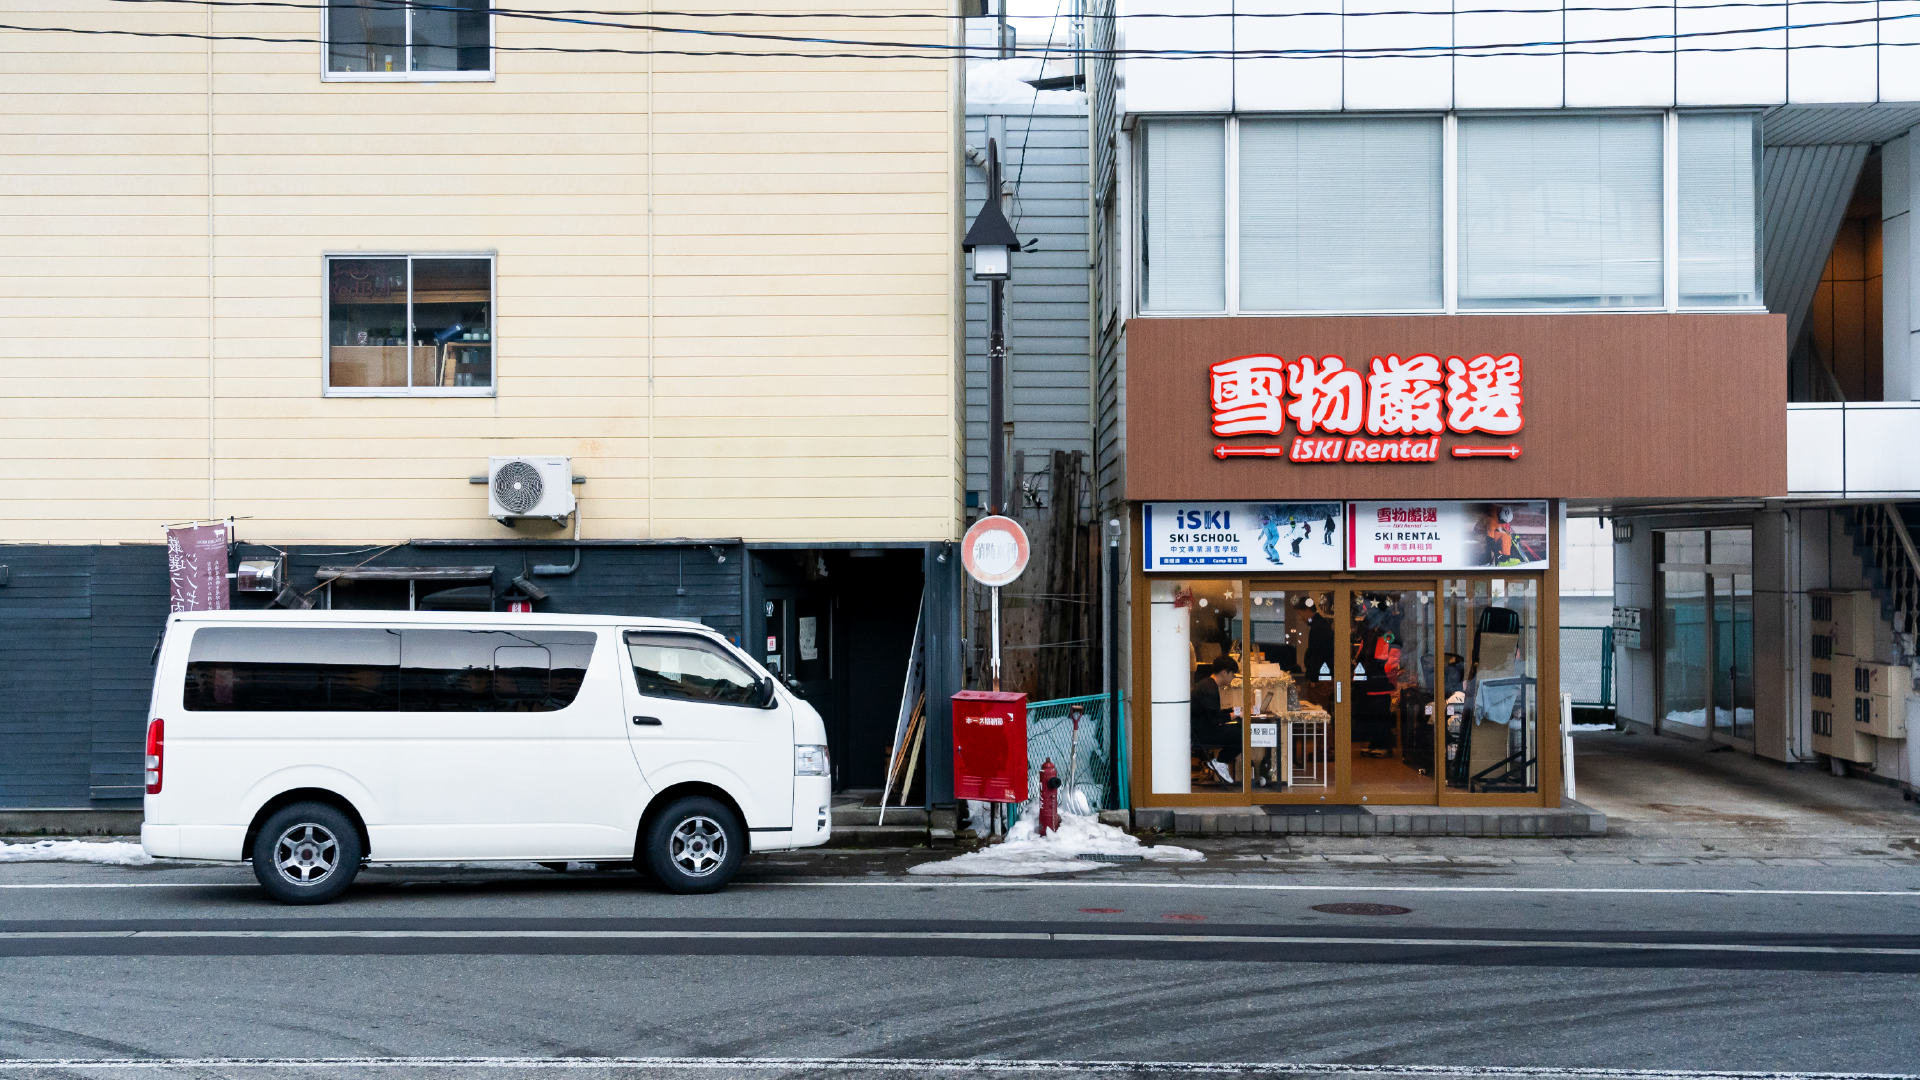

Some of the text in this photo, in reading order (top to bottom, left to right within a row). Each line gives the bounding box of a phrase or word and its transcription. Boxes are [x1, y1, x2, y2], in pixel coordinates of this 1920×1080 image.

[1290, 436, 1441, 462] iSKI Rental
[1177, 509, 1230, 530] iSKI
[1169, 533, 1240, 543] SKI SCHOOL
[1375, 532, 1441, 541] SKI RENTAL
[975, 542, 1017, 562] 消防水利
[1170, 545, 1238, 553] 中文專業滑雪學校
